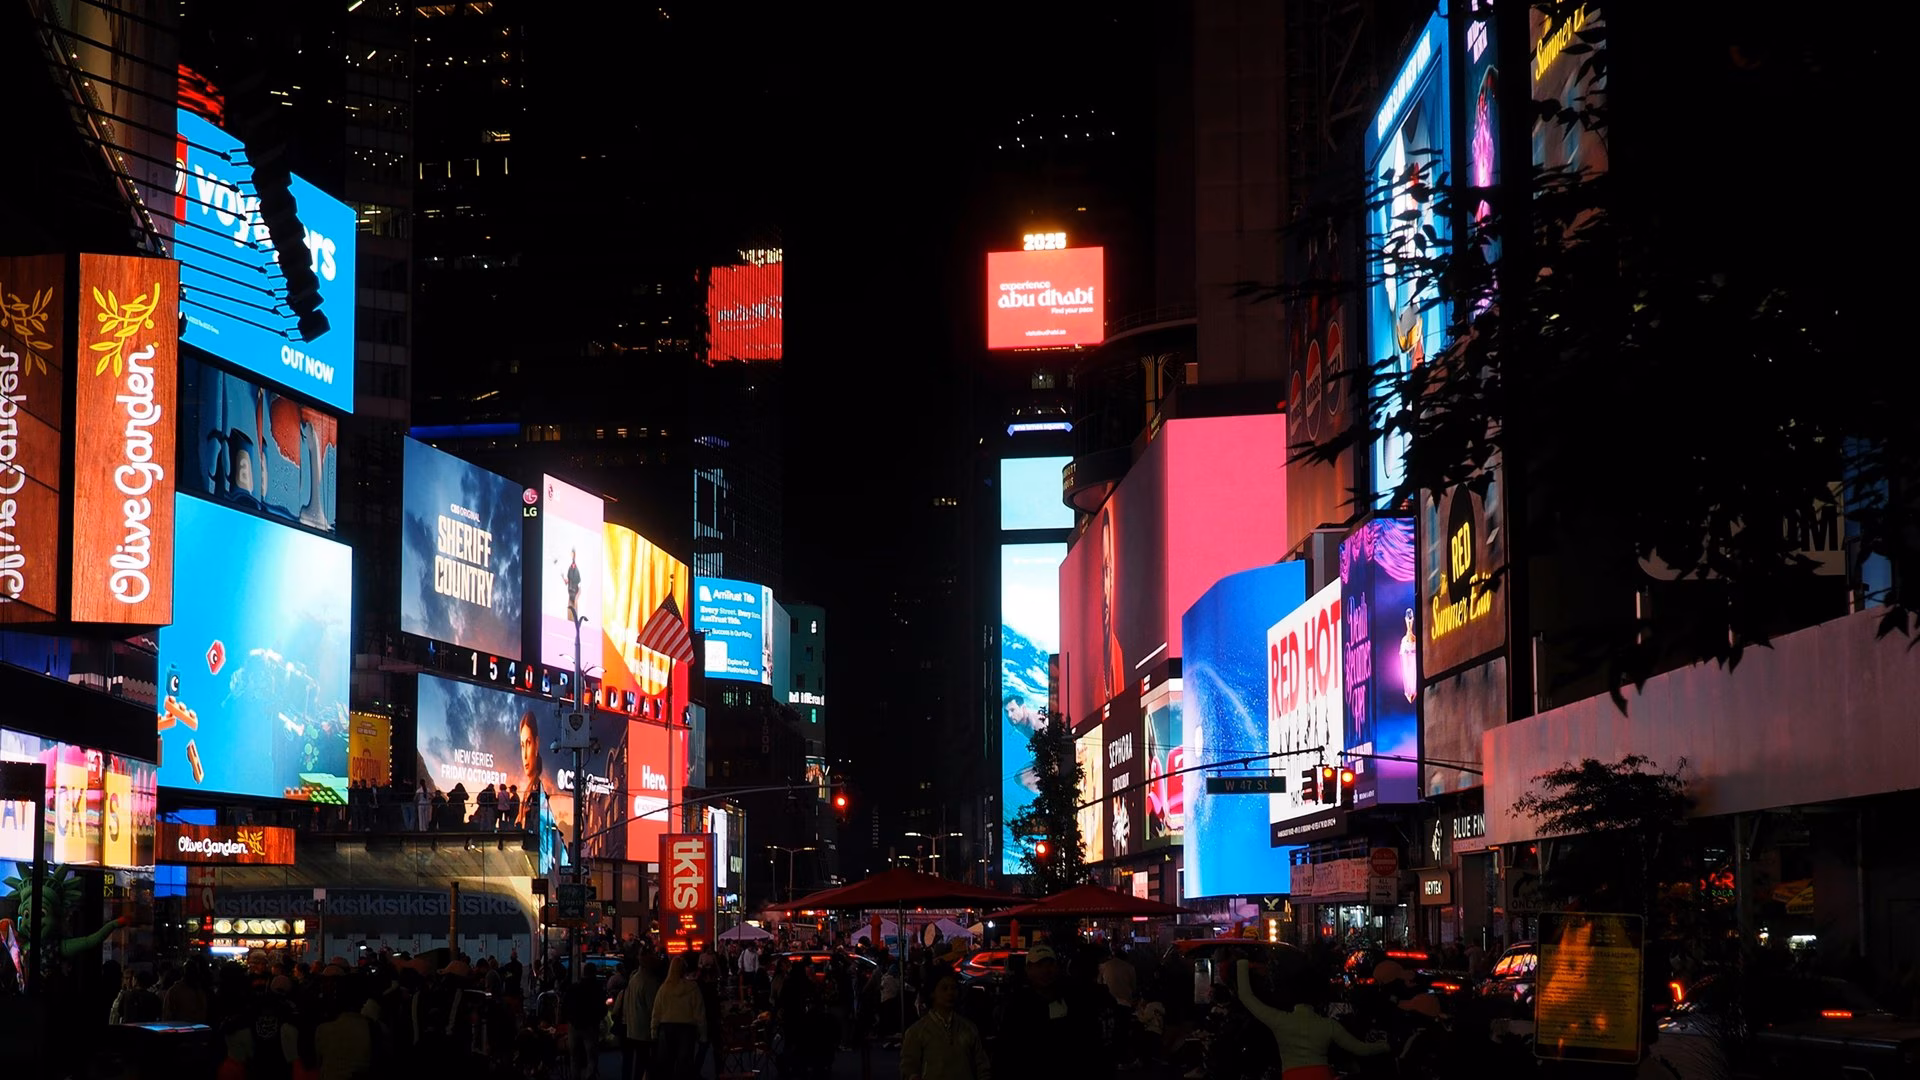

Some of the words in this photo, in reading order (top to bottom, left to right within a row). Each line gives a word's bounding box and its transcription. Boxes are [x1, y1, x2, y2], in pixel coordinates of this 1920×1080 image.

[1023, 232, 1067, 251] 2025
[998, 290, 1035, 308] abu
[1037, 286, 1094, 306] dhabi
[280, 345, 304, 370] OUT
[305, 354, 335, 385] NOW
[114, 344, 165, 498] Garden
[523, 507, 538, 517] LG
[110, 497, 151, 604] Olive
[437, 514, 493, 568] SHERIFF
[1451, 521, 1472, 583] RED
[434, 554, 495, 609] COUNTRY
[1271, 631, 1299, 721] RED
[1304, 599, 1341, 705] HOT
[453, 748, 471, 764] NEW
[471, 751, 494, 769] SERIES
[1108, 732, 1133, 769] SEPHORA
[441, 763, 467, 781] FRIDAY
[467, 768, 500, 786] OCTOBER
[1225, 780, 1235, 791] W
[1240, 780, 1252, 791] 47
[1257, 779, 1268, 791] St
[1453, 815, 1471, 839] BLUE
[1472, 813, 1486, 836] FIN
[178, 836, 204, 852] Olive
[203, 838, 248, 857] Garden
[673, 838, 706, 910] tkts
